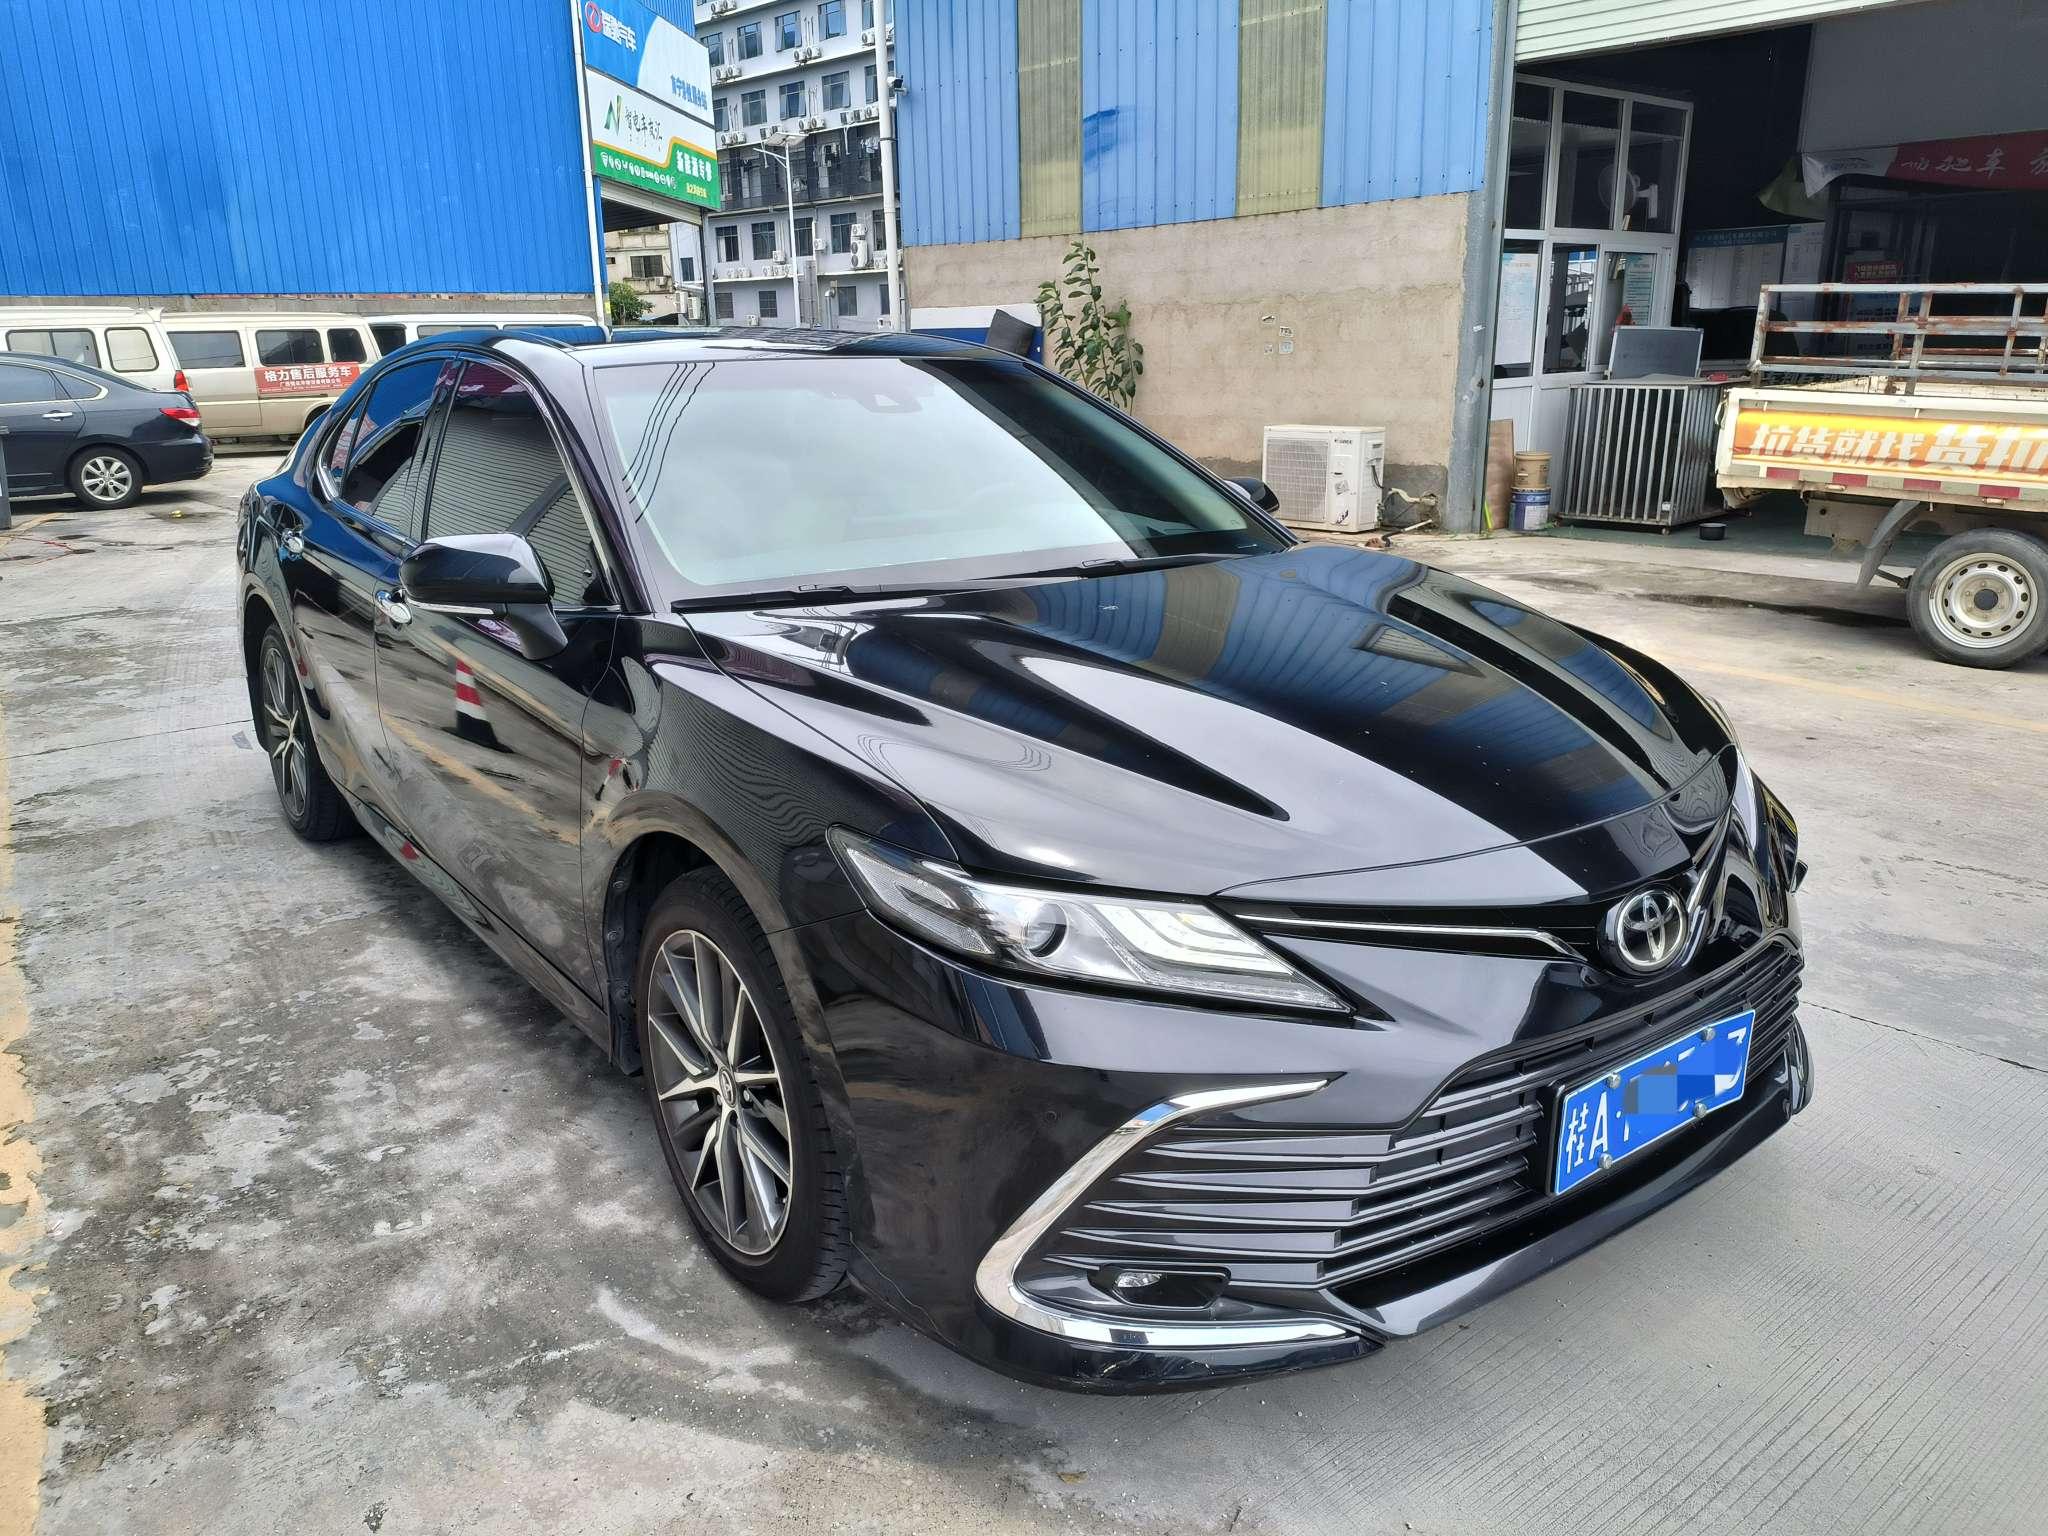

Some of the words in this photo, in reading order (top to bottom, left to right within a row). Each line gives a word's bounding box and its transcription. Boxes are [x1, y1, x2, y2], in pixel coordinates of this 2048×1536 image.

[264, 366, 352, 382] 格力售后服务车
